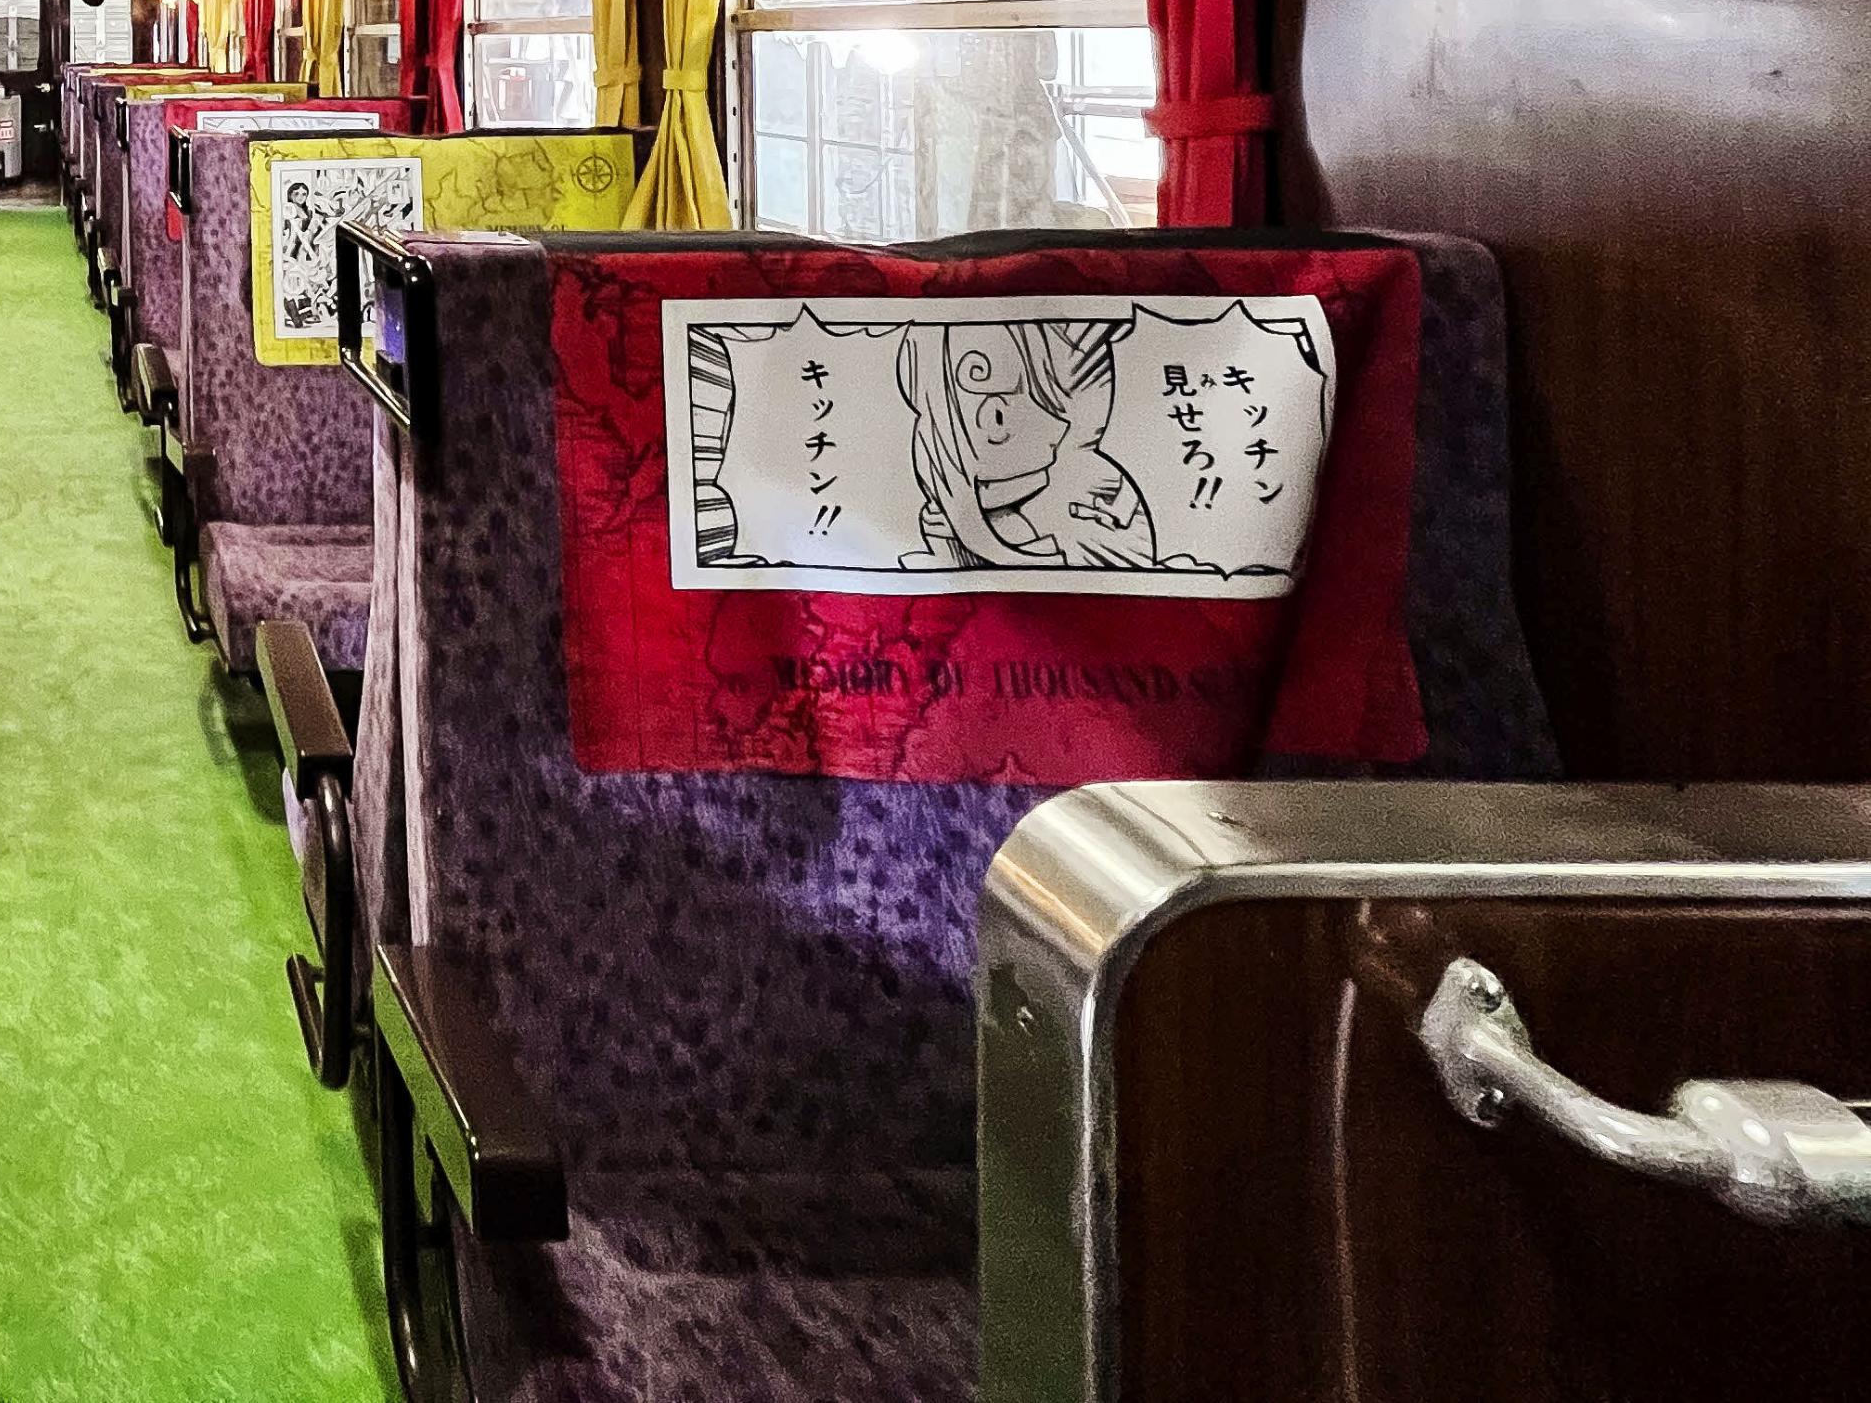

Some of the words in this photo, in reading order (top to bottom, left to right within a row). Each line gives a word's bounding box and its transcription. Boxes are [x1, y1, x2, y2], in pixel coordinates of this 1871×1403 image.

[800, 359, 842, 537] キッチン!!
[1223, 364, 1284, 505] キッチン
